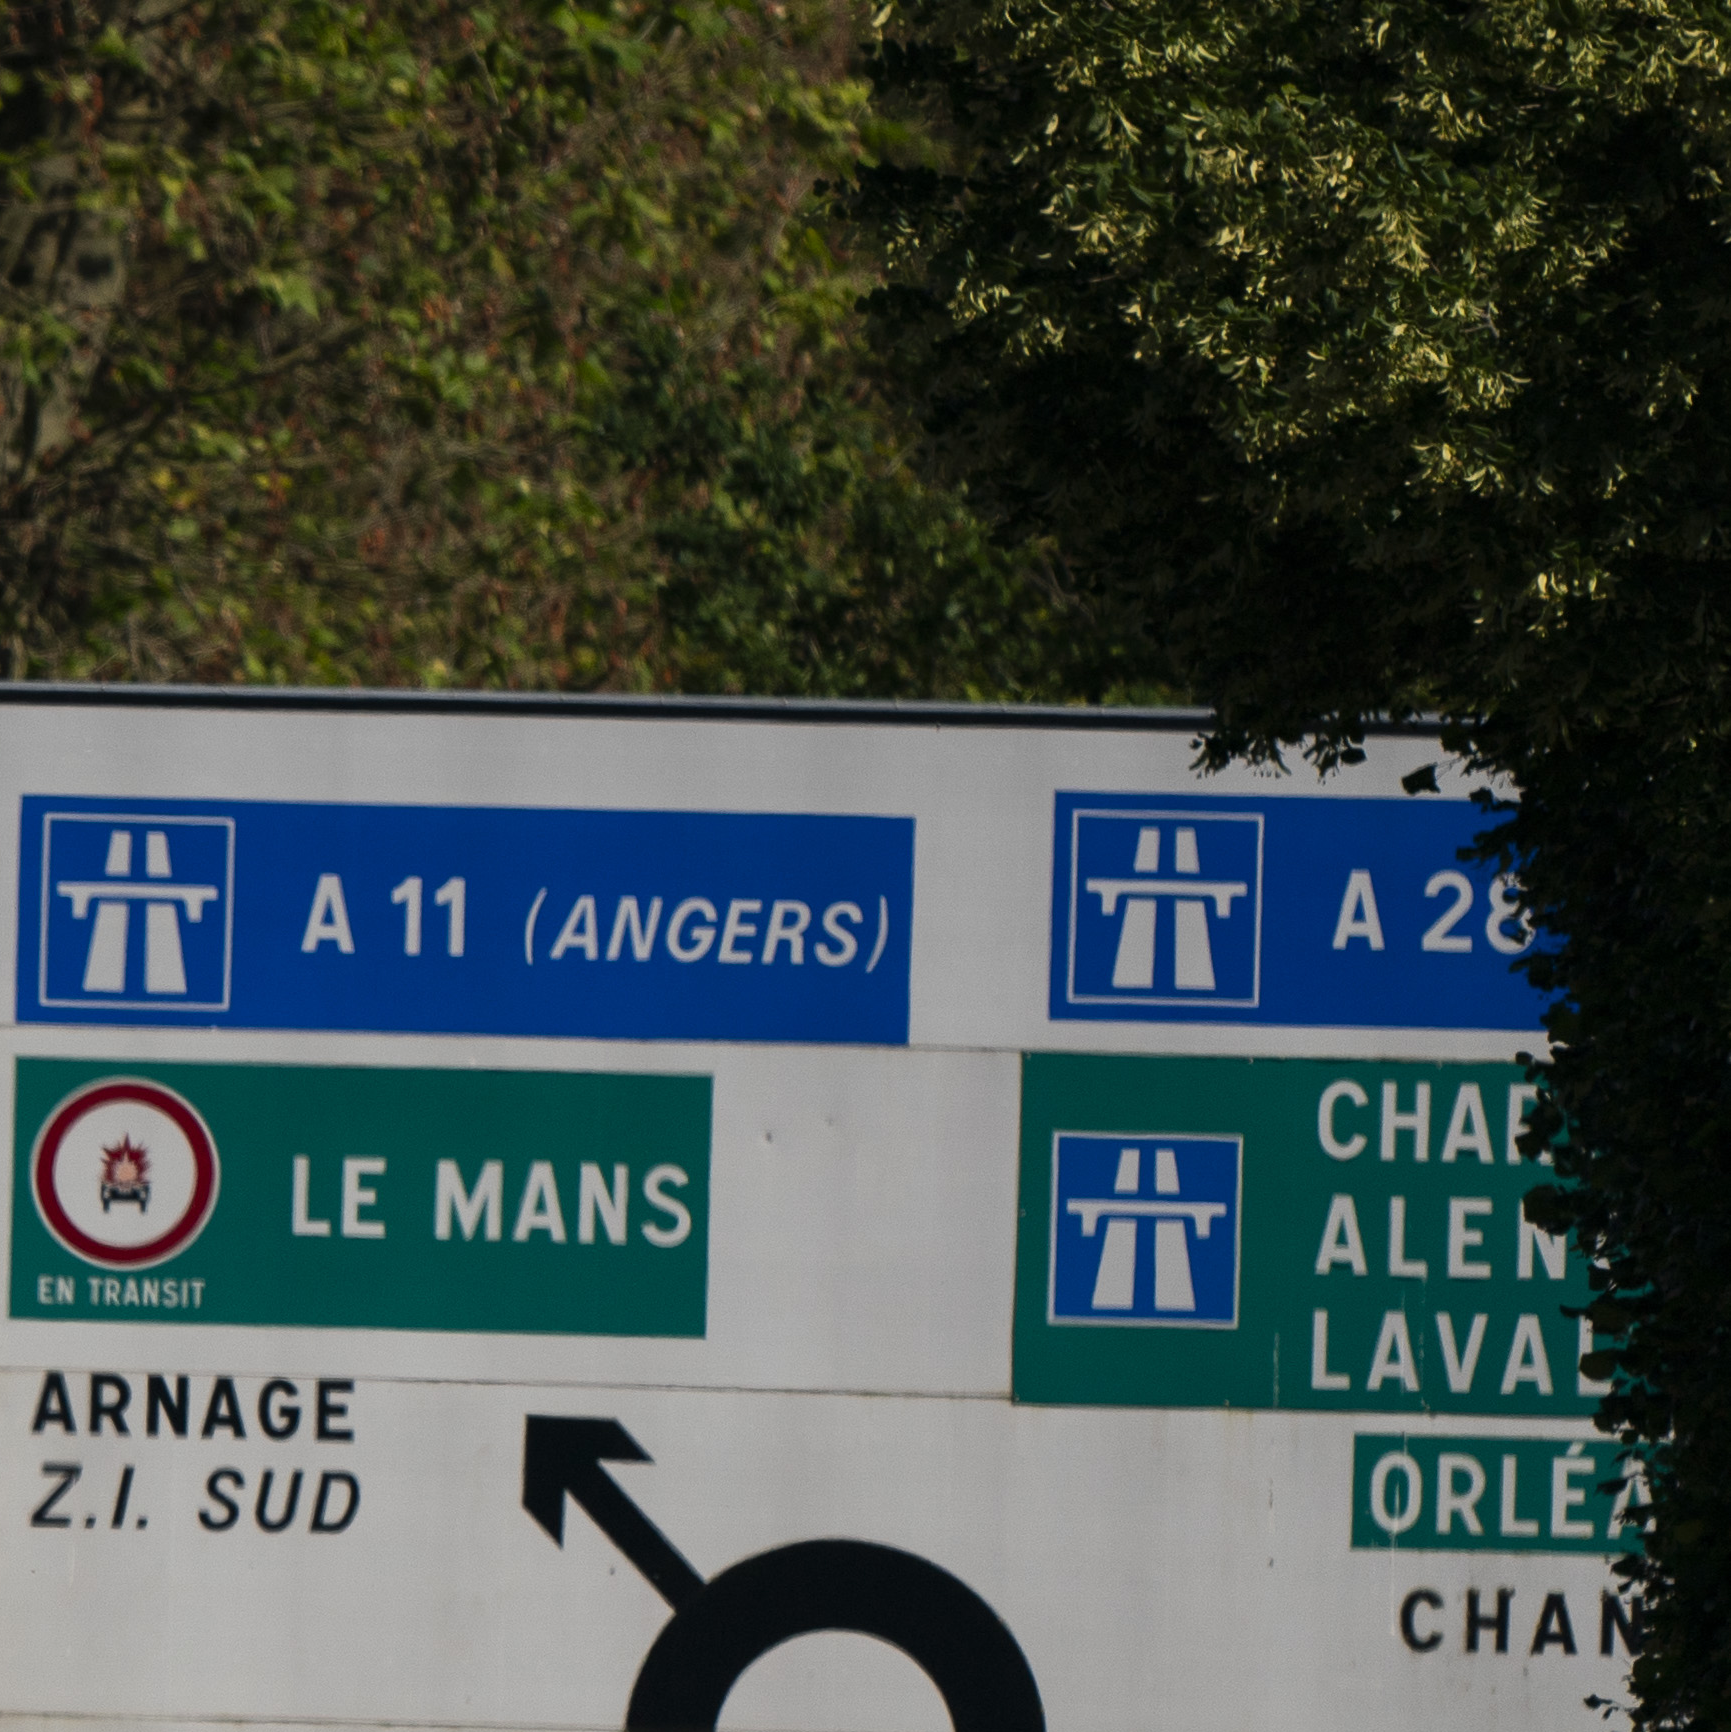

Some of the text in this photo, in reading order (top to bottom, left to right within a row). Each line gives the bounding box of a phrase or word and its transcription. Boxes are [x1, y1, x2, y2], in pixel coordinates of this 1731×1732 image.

[301, 873, 889, 973] A 11 (ANGERS)
[1332, 867, 1538, 955] A 28
[292, 1155, 693, 1248] LE MANS
[37, 1276, 206, 1309] EN TRANSIT
[31, 1372, 356, 1442] ARNAGE
[30, 1462, 362, 1534] Z.I. SUD
